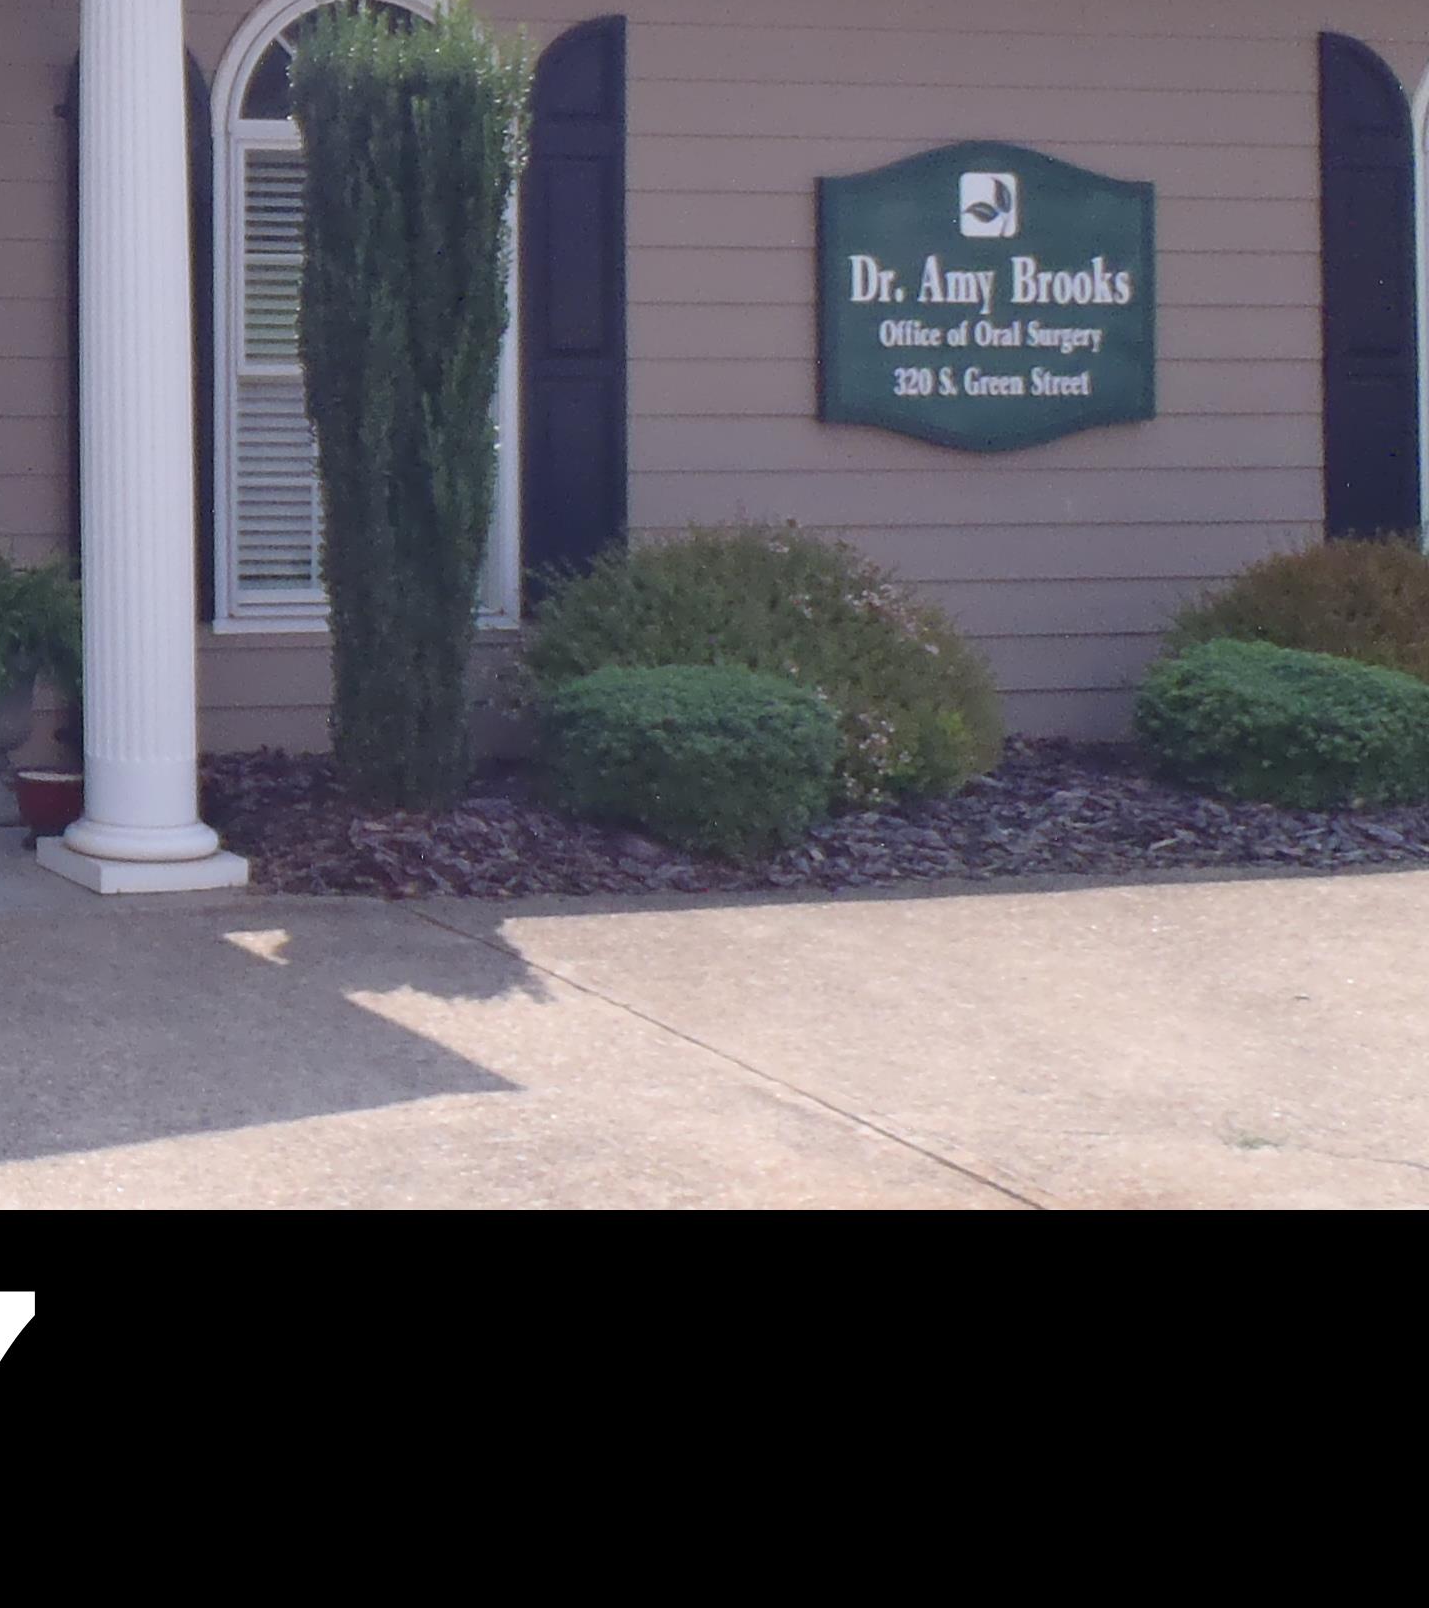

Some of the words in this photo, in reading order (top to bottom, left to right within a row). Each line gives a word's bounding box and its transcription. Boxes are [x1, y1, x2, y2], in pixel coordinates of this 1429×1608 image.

[848, 254, 905, 303] Dr.
[917, 255, 995, 315] Amy
[1010, 256, 1131, 305] Brooks
[879, 320, 942, 347] Office
[946, 320, 969, 347] of
[974, 321, 1022, 347] Oral
[1026, 321, 1103, 353] Surgery
[893, 367, 934, 396] 320
[939, 367, 958, 396] S.
[963, 367, 1025, 396] Green
[1031, 367, 1090, 396] Street
